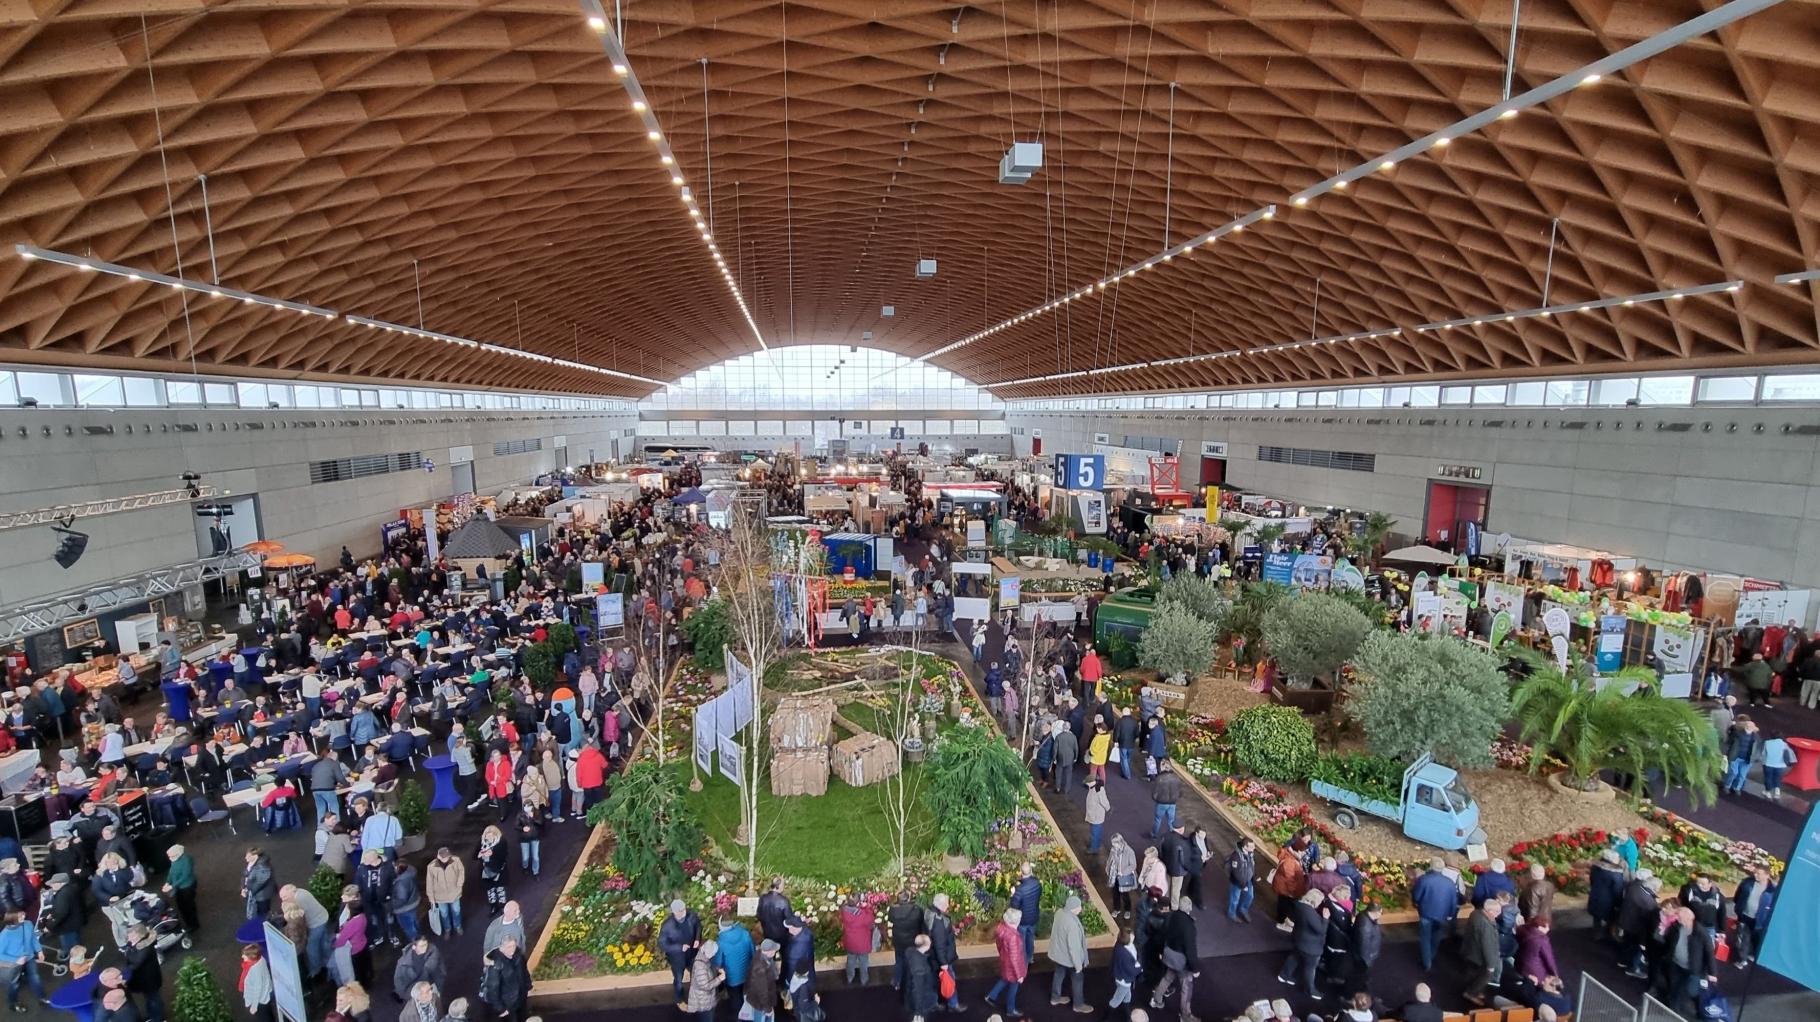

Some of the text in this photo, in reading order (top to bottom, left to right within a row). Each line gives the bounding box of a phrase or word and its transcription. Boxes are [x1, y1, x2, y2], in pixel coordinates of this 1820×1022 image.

[894, 428, 901, 439] 4
[1057, 457, 1065, 486] 5
[1078, 457, 1095, 488] 5
